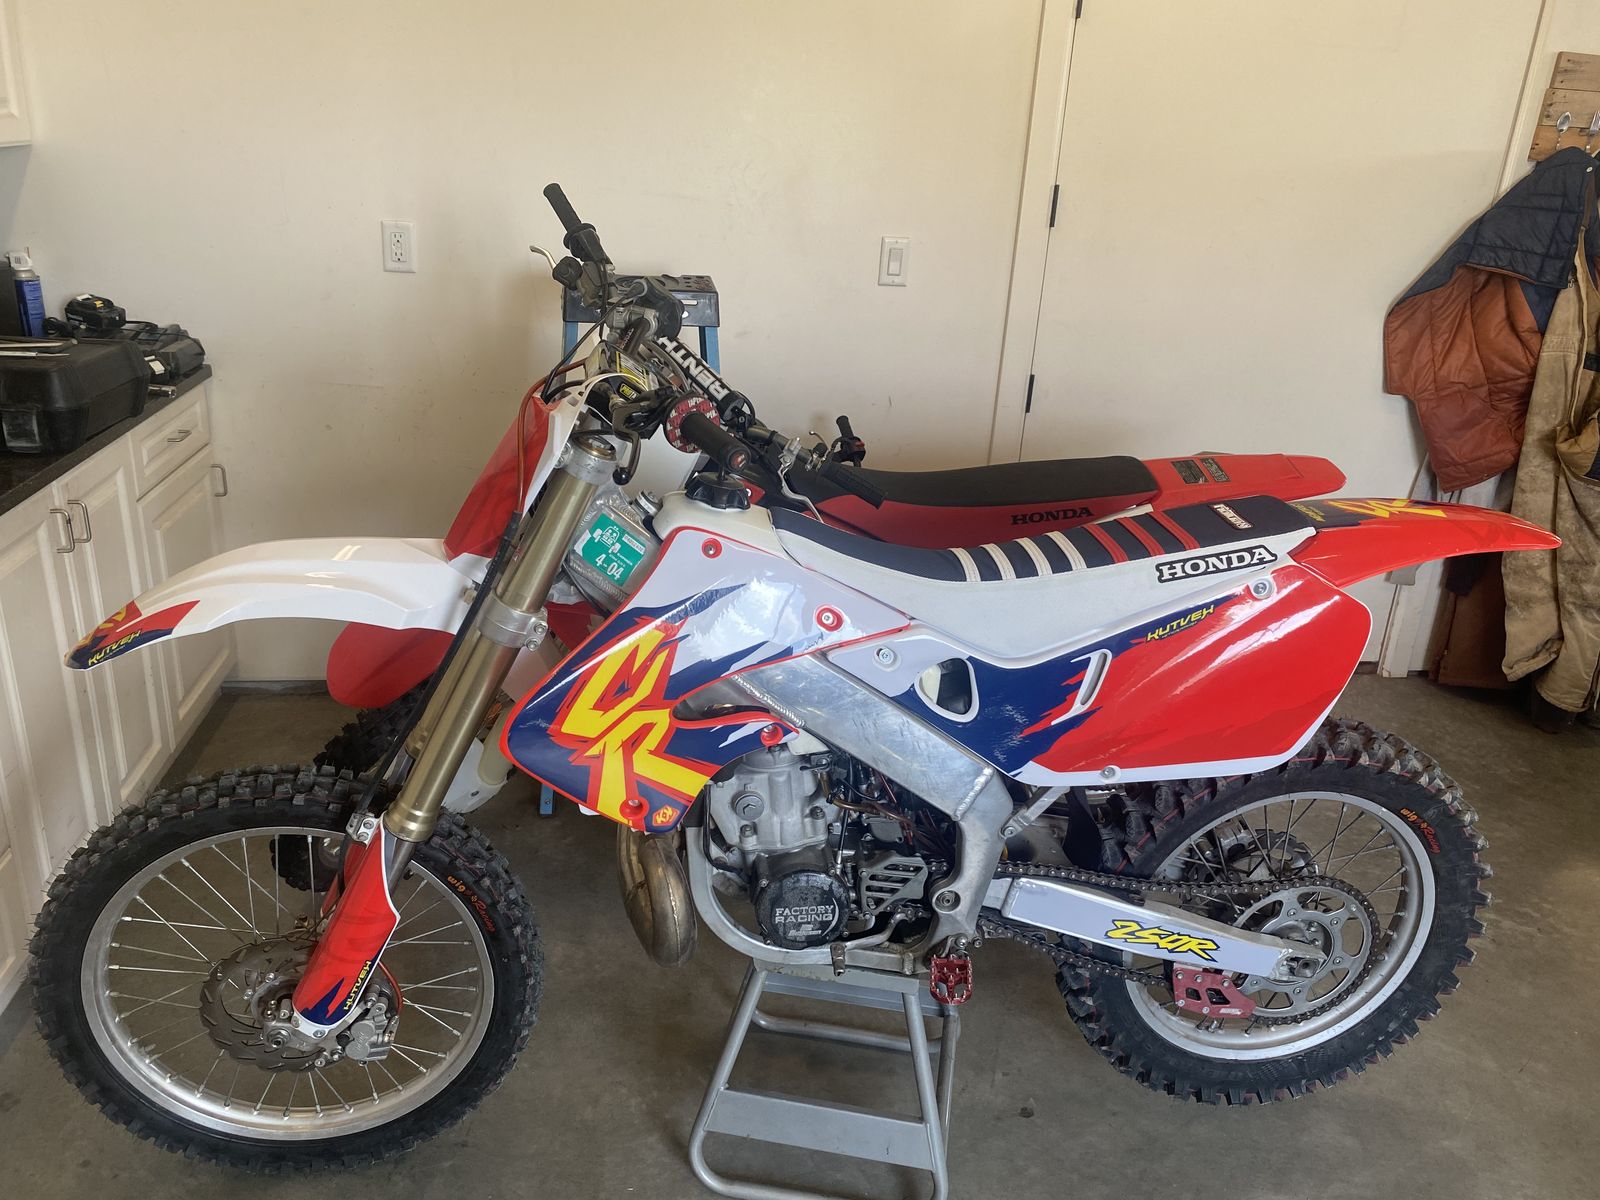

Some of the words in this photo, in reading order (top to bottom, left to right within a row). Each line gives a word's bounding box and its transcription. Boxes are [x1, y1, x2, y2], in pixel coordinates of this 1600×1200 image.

[1011, 506, 1095, 526] HONDA
[595, 553, 624, 580] 4-04
[1158, 546, 1277, 581] HONDA
[775, 904, 835, 917] FACTORY
[775, 913, 834, 924] RACING
